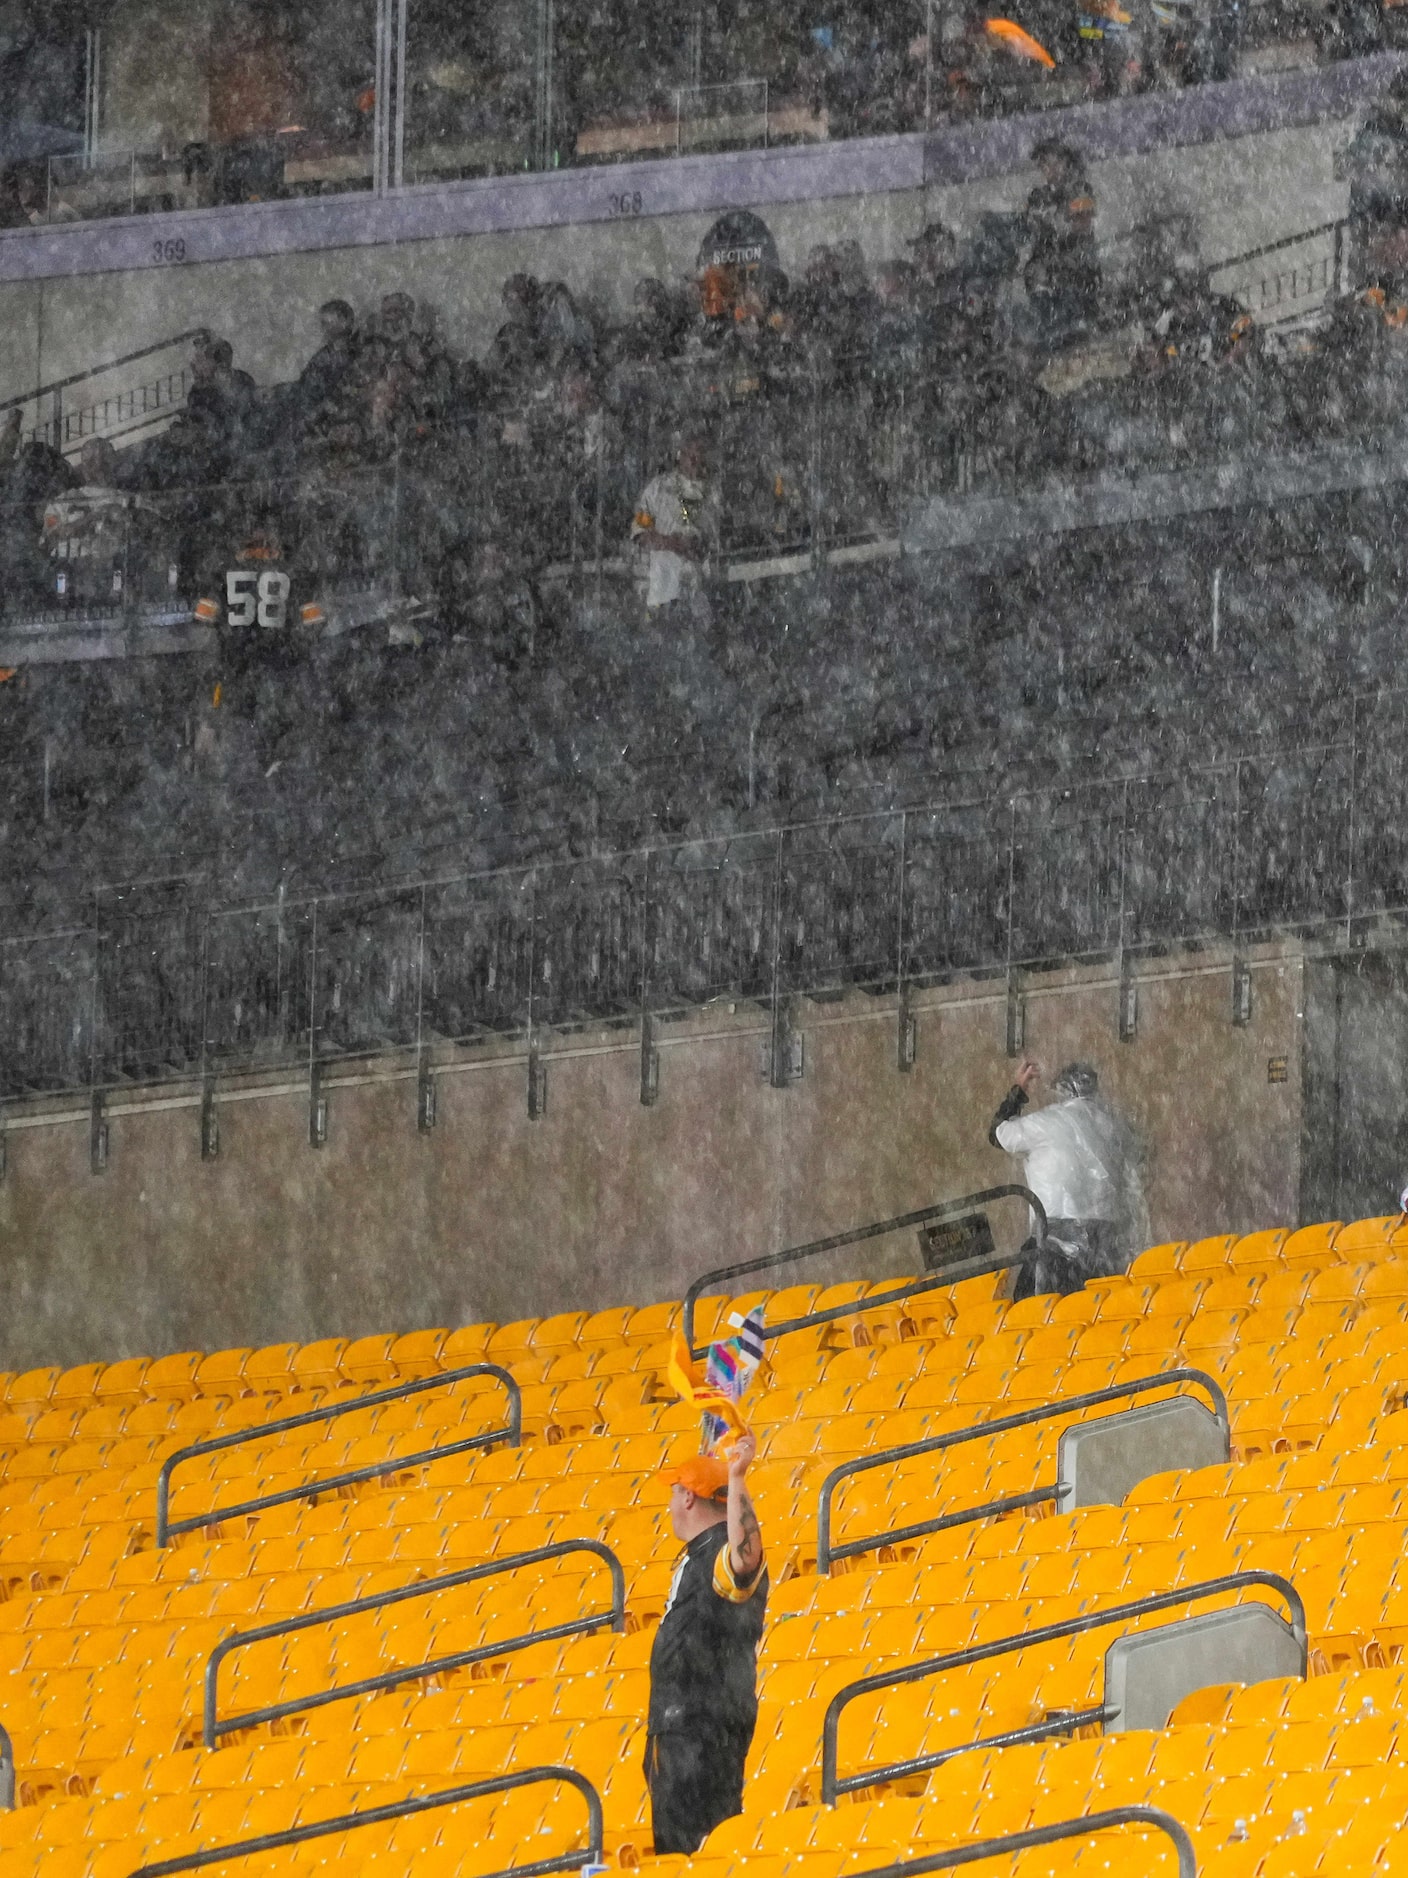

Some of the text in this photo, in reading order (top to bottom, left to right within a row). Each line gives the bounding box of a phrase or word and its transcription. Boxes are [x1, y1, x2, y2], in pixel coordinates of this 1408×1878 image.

[153, 238, 185, 263] 369
[713, 245, 761, 265] SECTION
[226, 571, 290, 628] 58
